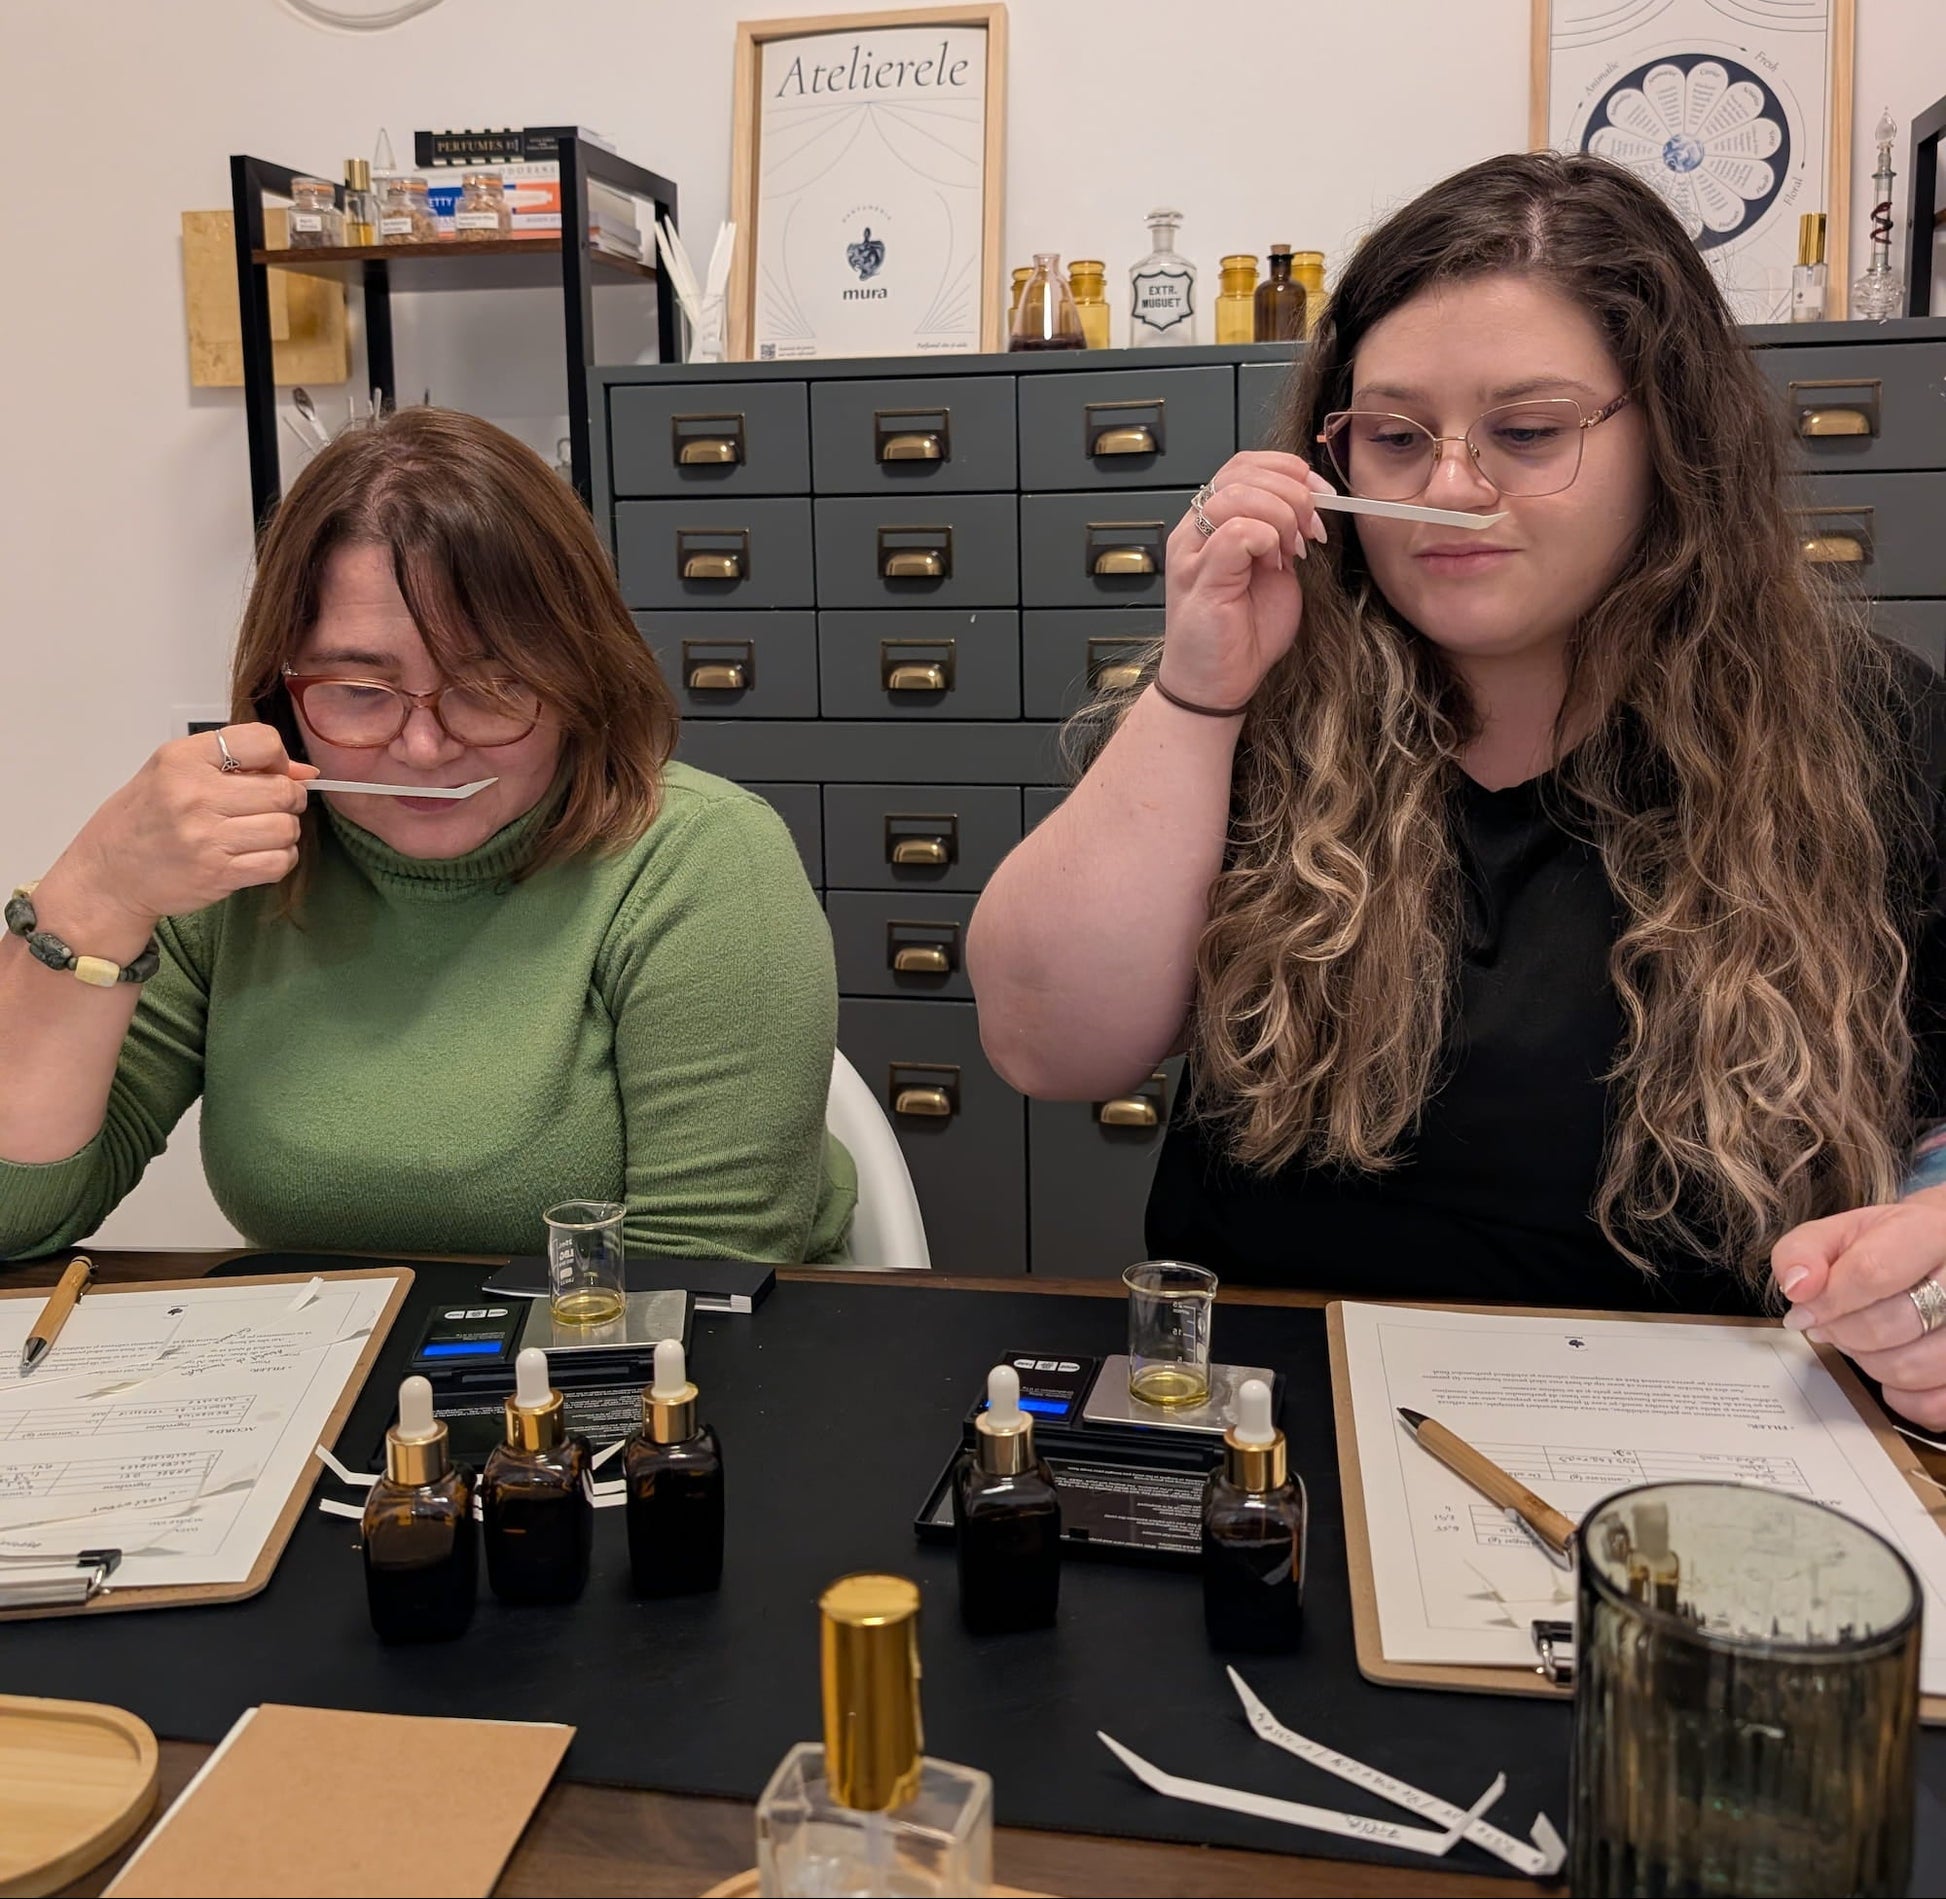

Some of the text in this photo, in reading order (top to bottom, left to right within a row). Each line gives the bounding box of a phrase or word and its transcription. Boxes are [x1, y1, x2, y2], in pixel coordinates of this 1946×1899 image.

[1754, 50, 1779, 73] Fresh
[776, 41, 969, 98] Atelierele
[437, 140, 503, 152] PERFUMES
[1783, 176, 1803, 208] Floral
[842, 287, 888, 301] mura
[1148, 285, 1178, 296] EXTR.
[1141, 297, 1182, 308] MUGUET
